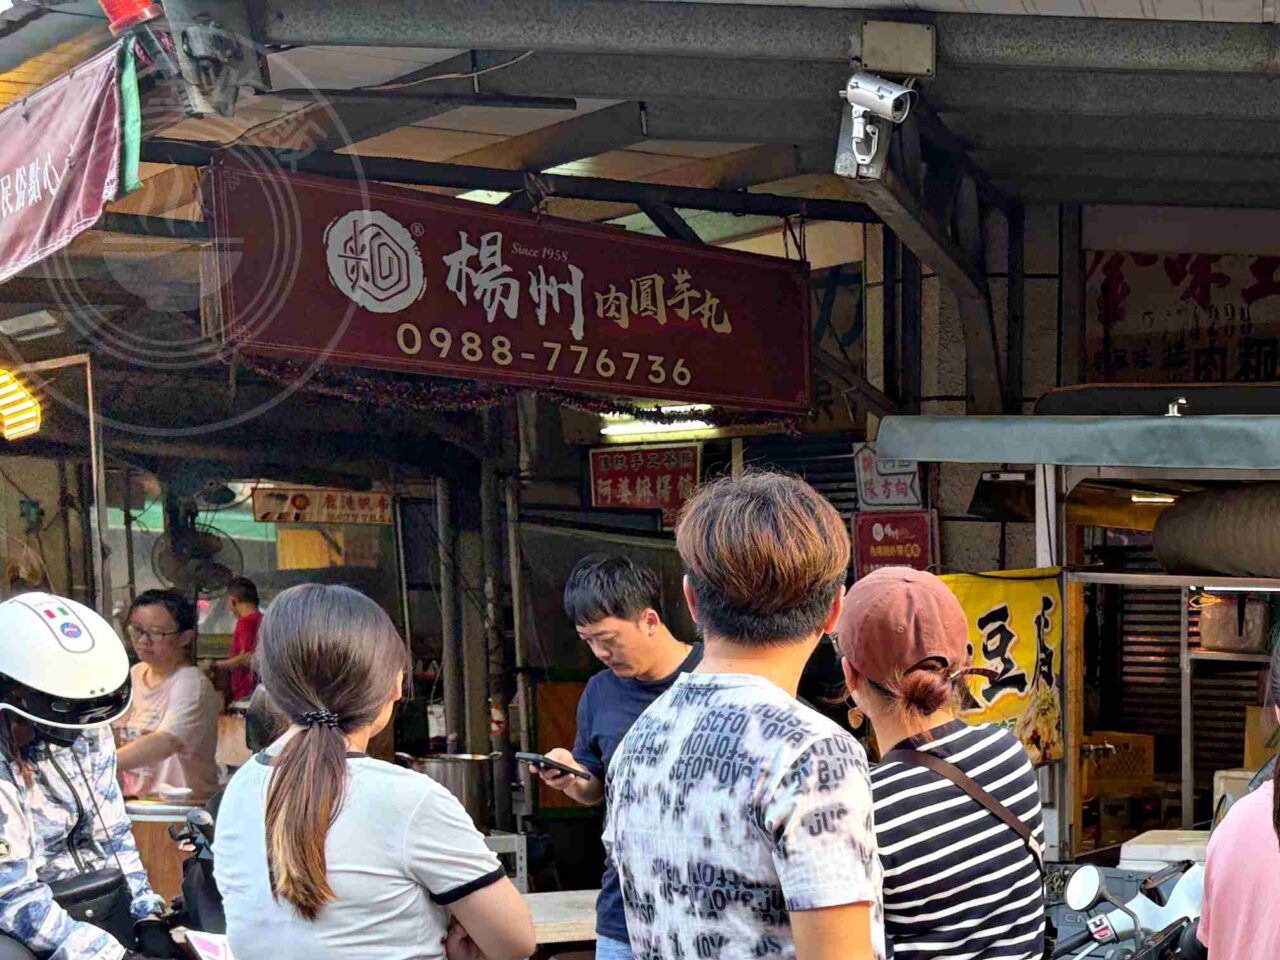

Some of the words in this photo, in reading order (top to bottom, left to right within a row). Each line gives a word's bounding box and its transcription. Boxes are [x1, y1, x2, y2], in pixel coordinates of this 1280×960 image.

[442, 230, 586, 341] 楊州
[510, 241, 539, 258] Since
[540, 246, 570, 264] 1958
[594, 267, 733, 335] 肉圓芋丸
[395, 322, 693, 388] 0988-776736
